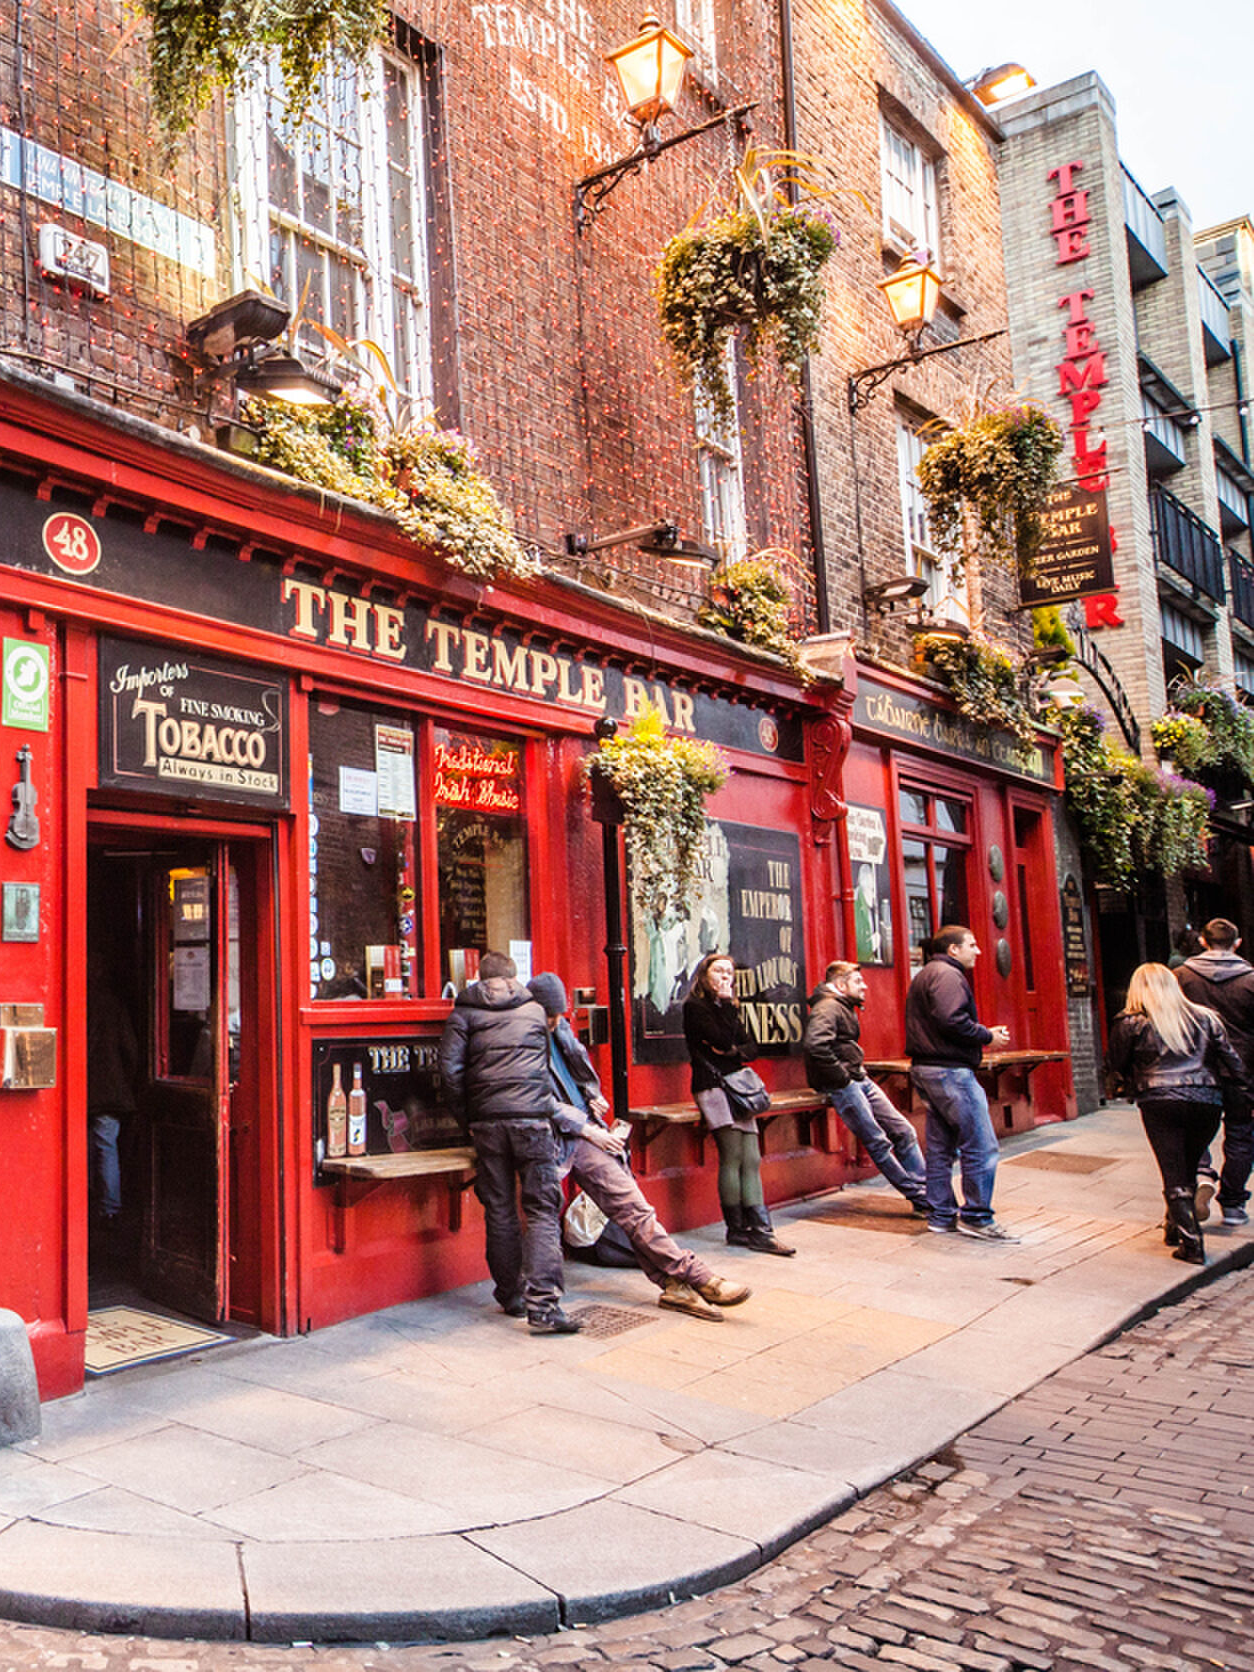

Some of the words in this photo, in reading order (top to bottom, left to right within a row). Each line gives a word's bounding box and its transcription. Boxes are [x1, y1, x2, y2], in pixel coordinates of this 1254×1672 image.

[1046, 160, 1092, 267] THE
[1055, 287, 1110, 493] TEMPLE
[52, 520, 89, 561] 48
[1056, 545, 1099, 561] GARDEN
[1050, 581, 1082, 594] DAILY
[1061, 570, 1095, 584] MUSIC
[282, 578, 408, 663] THE
[426, 618, 608, 713] TEMPLE
[622, 675, 697, 733] BAR
[109, 661, 189, 699] Importers
[159, 685, 175, 697] OF
[180, 697, 209, 716] FINE
[210, 703, 265, 727] SMOKING
[131, 698, 267, 769] TOBACCO
[161, 759, 213, 780] Always
[220, 772, 233, 782] in
[237, 768, 276, 789] Stock
[434, 743, 515, 775] Traditional
[433, 771, 470, 801] Irish
[475, 779, 520, 810] Music
[767, 860, 790, 889] THE
[740, 889, 793, 922] EMPEROR
[755, 956, 799, 993] LIQUORS
[368, 1045, 411, 1074] THE
